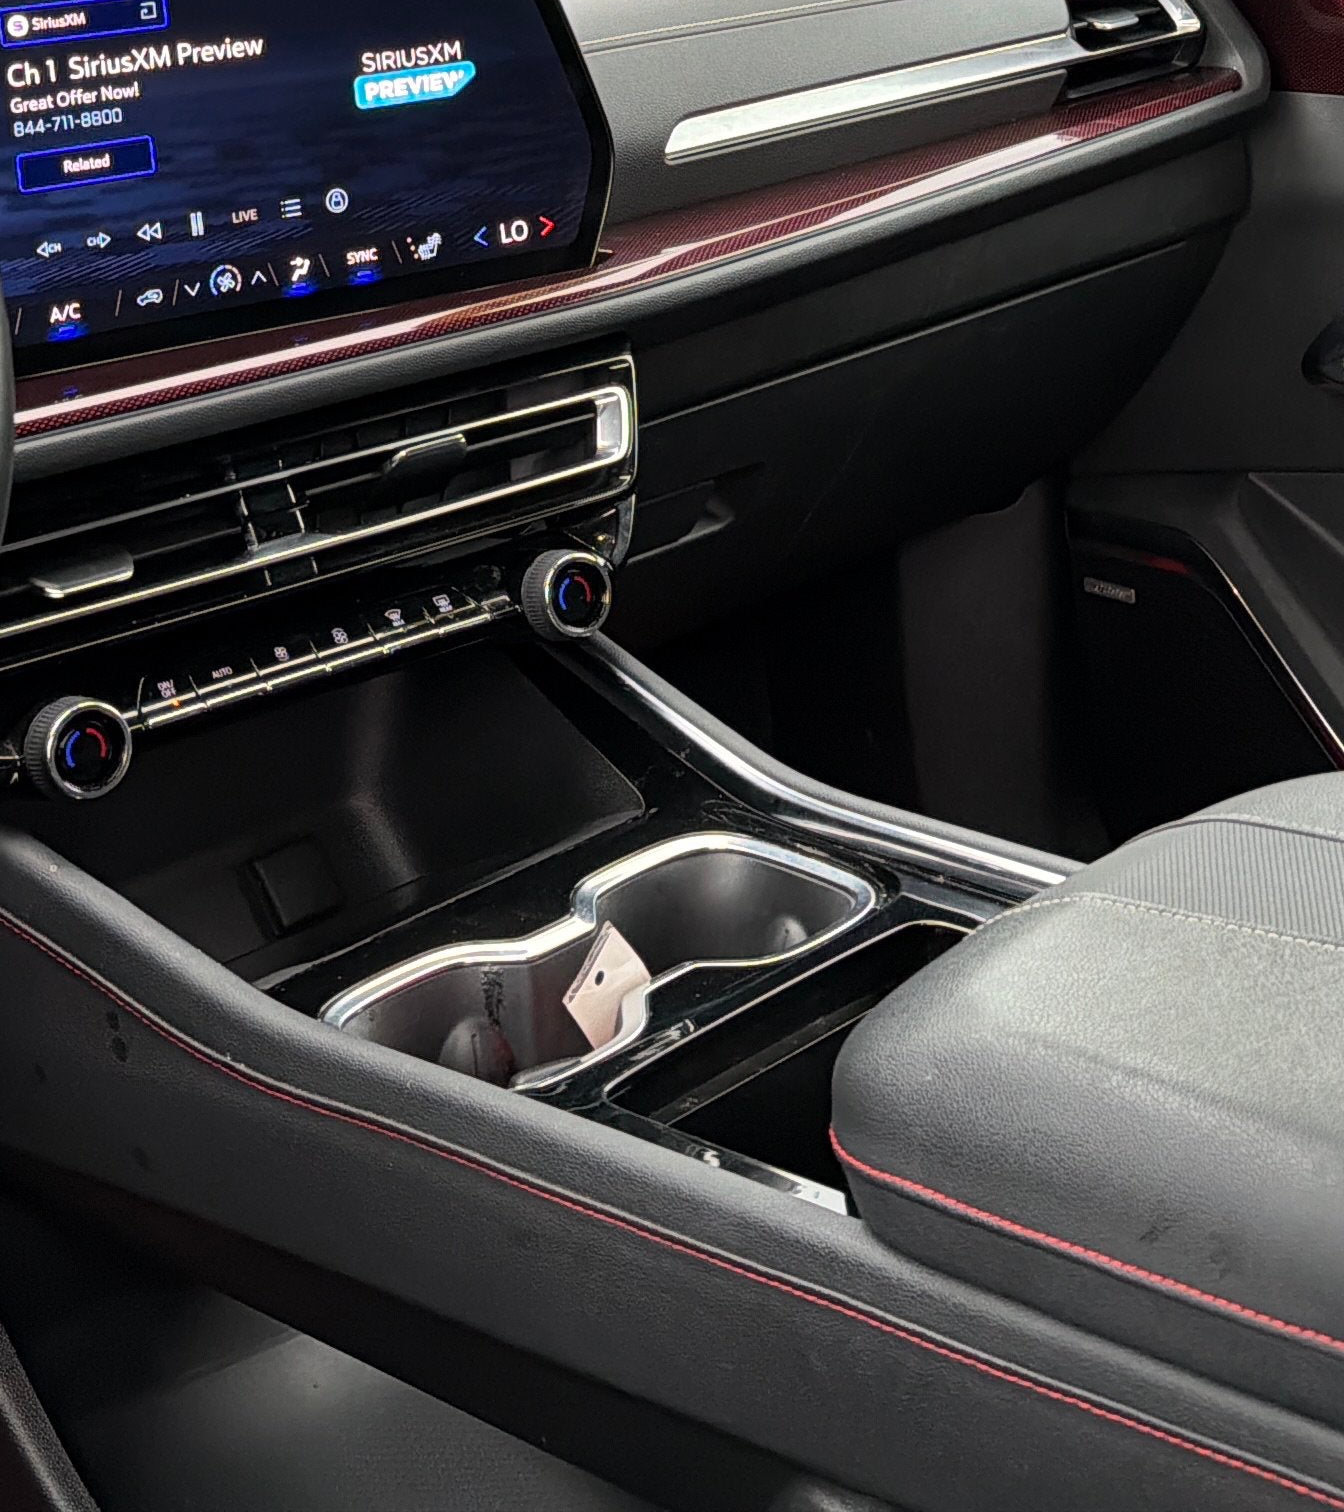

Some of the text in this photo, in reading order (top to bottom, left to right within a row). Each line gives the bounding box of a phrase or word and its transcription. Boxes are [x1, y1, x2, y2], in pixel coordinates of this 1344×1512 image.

[31, 12, 86, 31] SiriusXM
[7, 38, 264, 88] Ch 1 SiriusXM Preview
[361, 40, 462, 73] SIRIUSXM
[364, 69, 464, 102] PREVIEW
[10, 82, 140, 114] Great Offer Now!
[13, 108, 123, 138] 844-711-8800
[63, 154, 110, 173] Related
[231, 208, 258, 224] LIVE
[500, 220, 529, 244] LO
[346, 247, 378, 265] SYNC
[50, 302, 81, 324] A/C
[212, 666, 233, 679] AUTO
